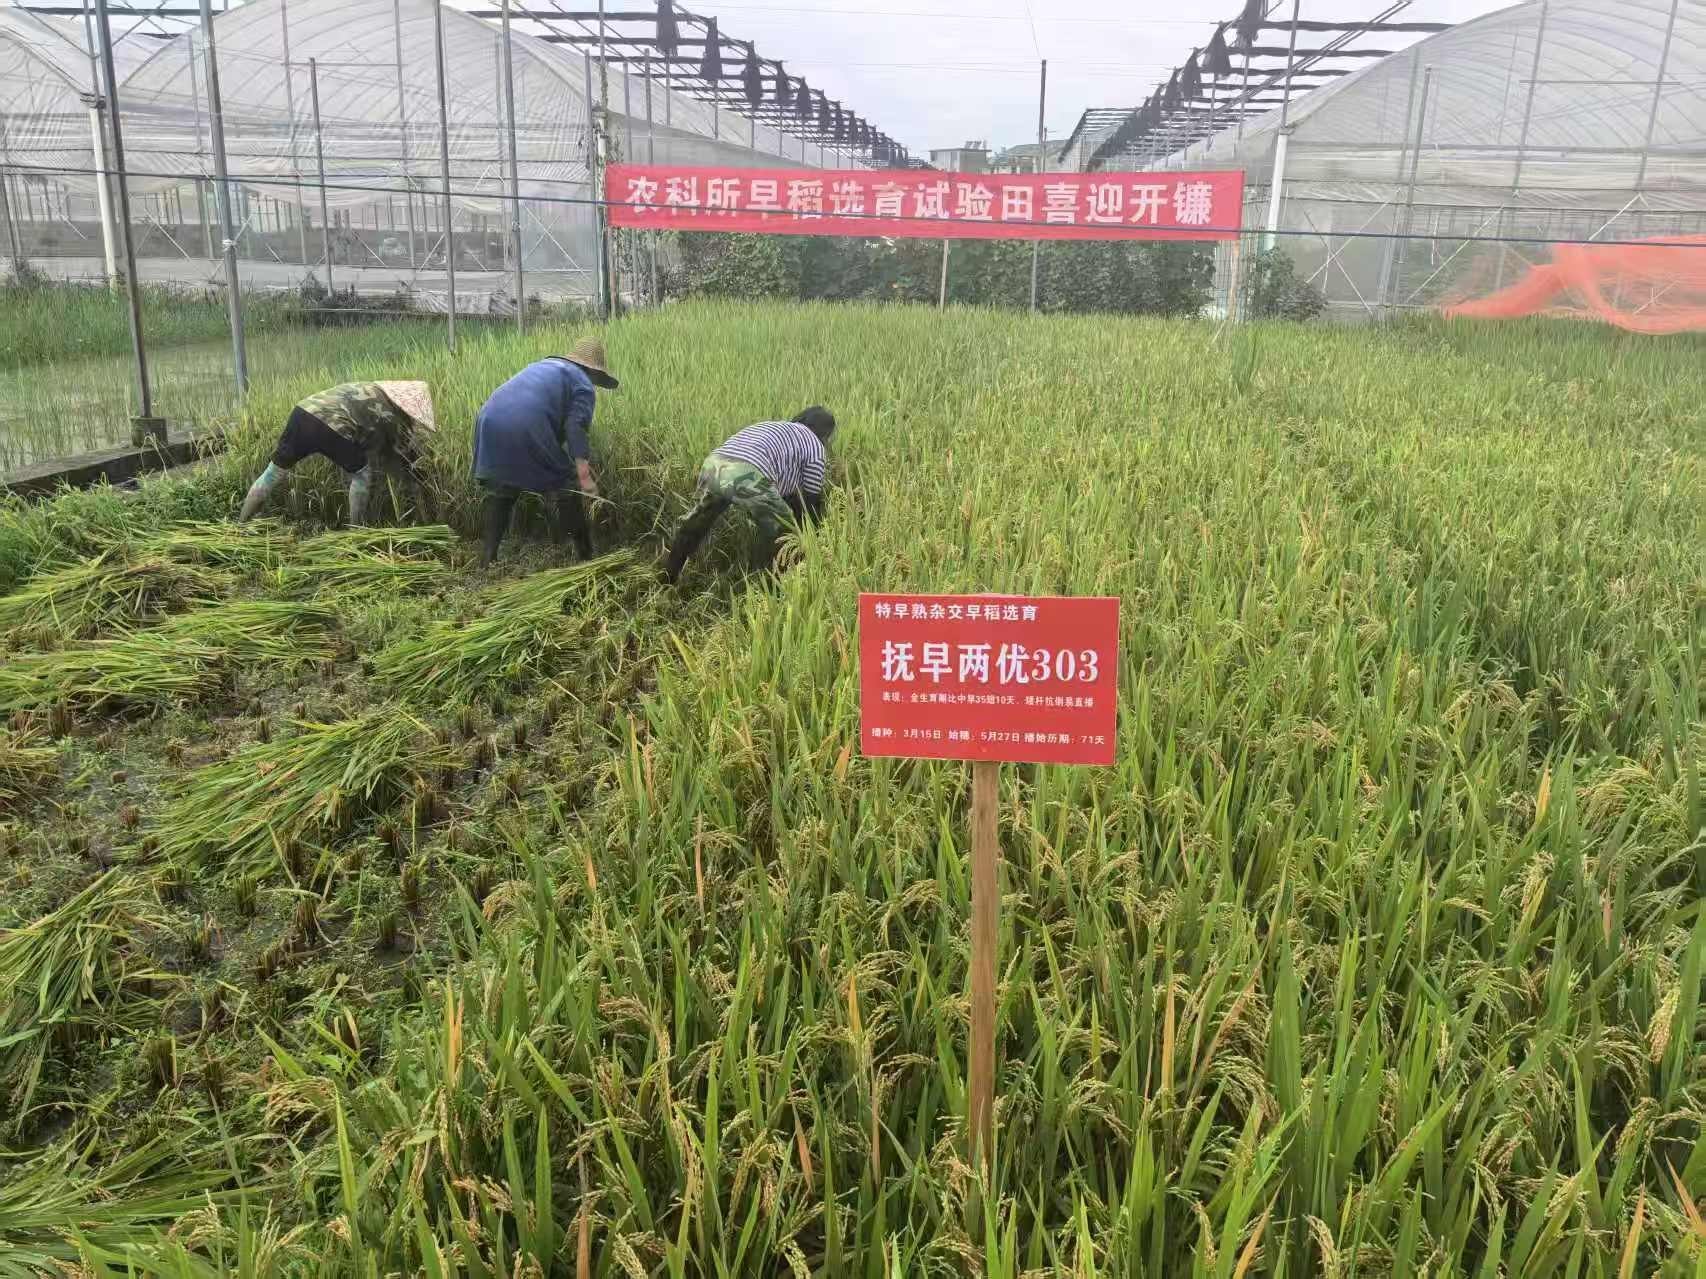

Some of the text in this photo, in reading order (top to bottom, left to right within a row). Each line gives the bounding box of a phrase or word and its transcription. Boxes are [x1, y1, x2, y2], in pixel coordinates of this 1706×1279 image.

[625, 175, 1213, 225] 农科所早稻选育试验田喜迎开镰
[875, 602, 1039, 621] 特早熟杂交早稻选育
[881, 640, 1099, 684] 抚早两优303
